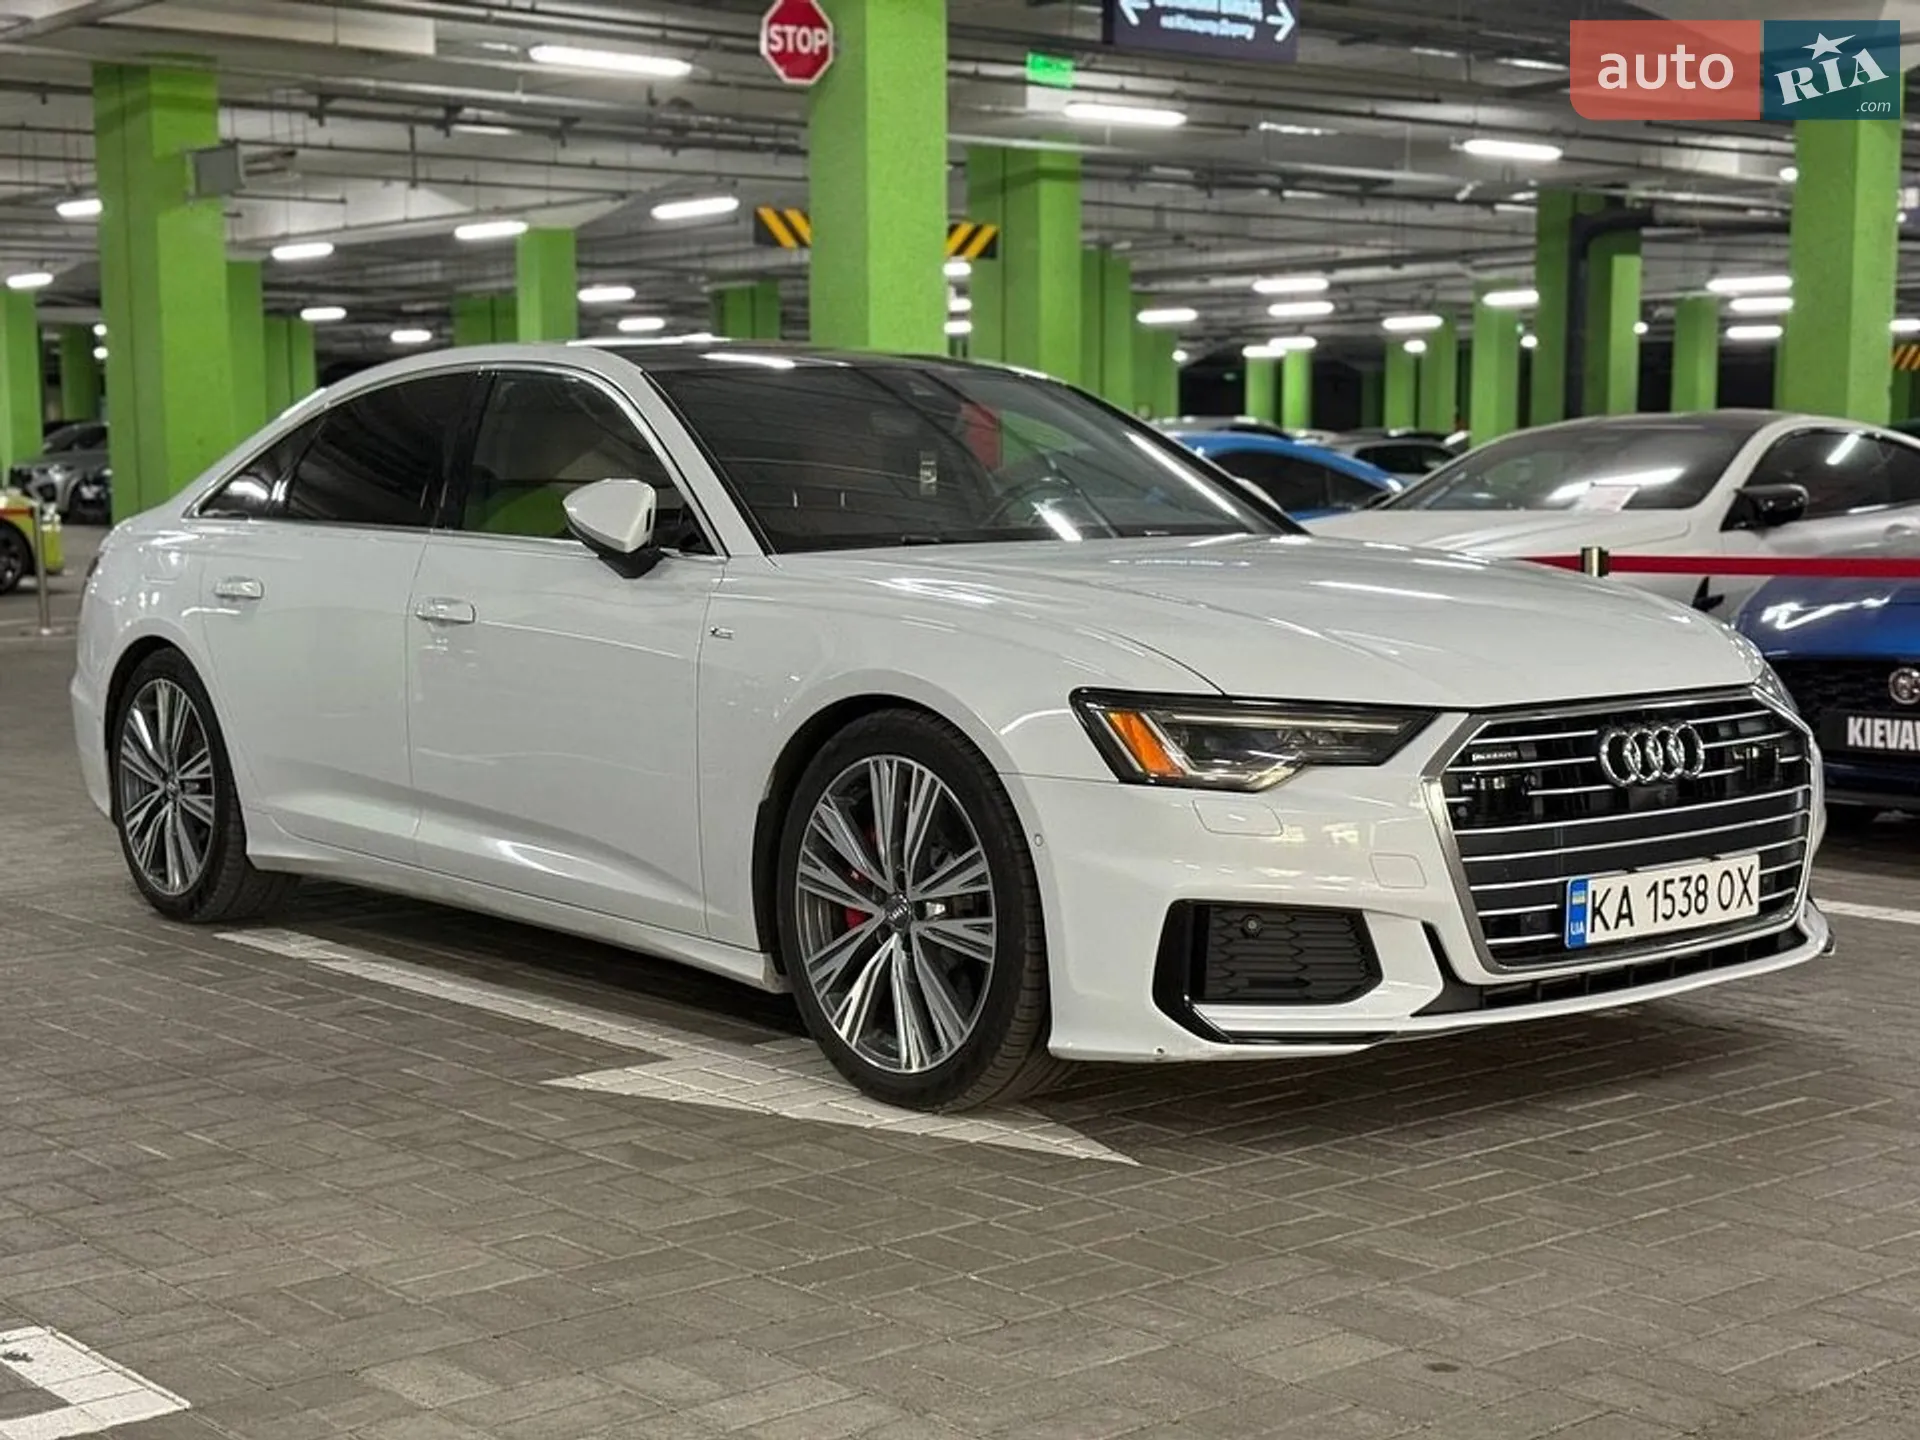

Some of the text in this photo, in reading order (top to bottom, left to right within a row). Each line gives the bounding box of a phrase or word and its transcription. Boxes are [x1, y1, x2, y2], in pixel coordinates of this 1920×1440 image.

[769, 24, 828, 55] STOP
[1590, 864, 1755, 934] KA 1538 OX
[1569, 922, 1586, 936] UA
